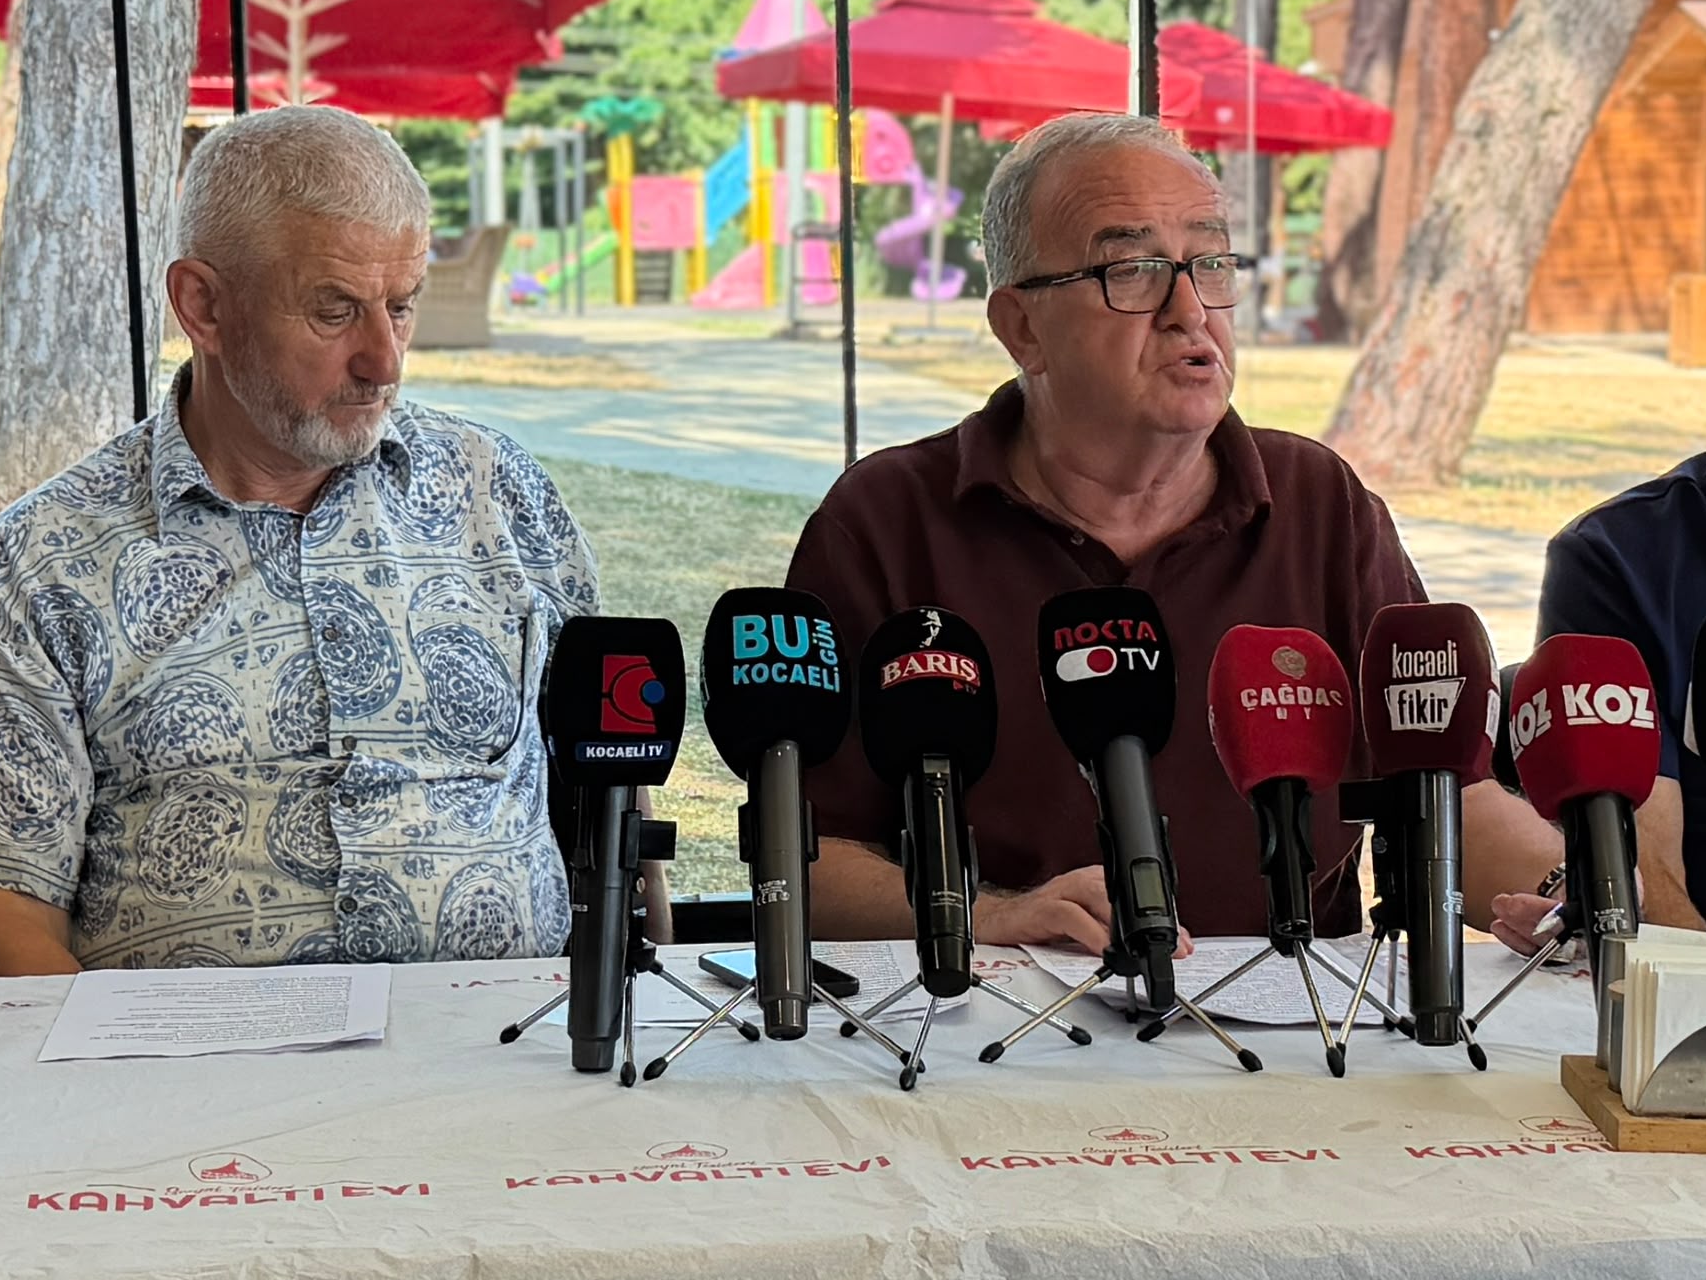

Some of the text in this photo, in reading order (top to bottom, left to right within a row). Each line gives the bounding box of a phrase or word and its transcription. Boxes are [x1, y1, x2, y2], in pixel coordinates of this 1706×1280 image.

[732, 614, 810, 660] BU
[813, 618, 839, 666] GÜN
[1120, 647, 1161, 671] TV
[1392, 639, 1458, 679] kocaeli
[1397, 689, 1449, 725] fikir
[1562, 683, 1656, 729] KOZ
[648, 745, 664, 757] TV
